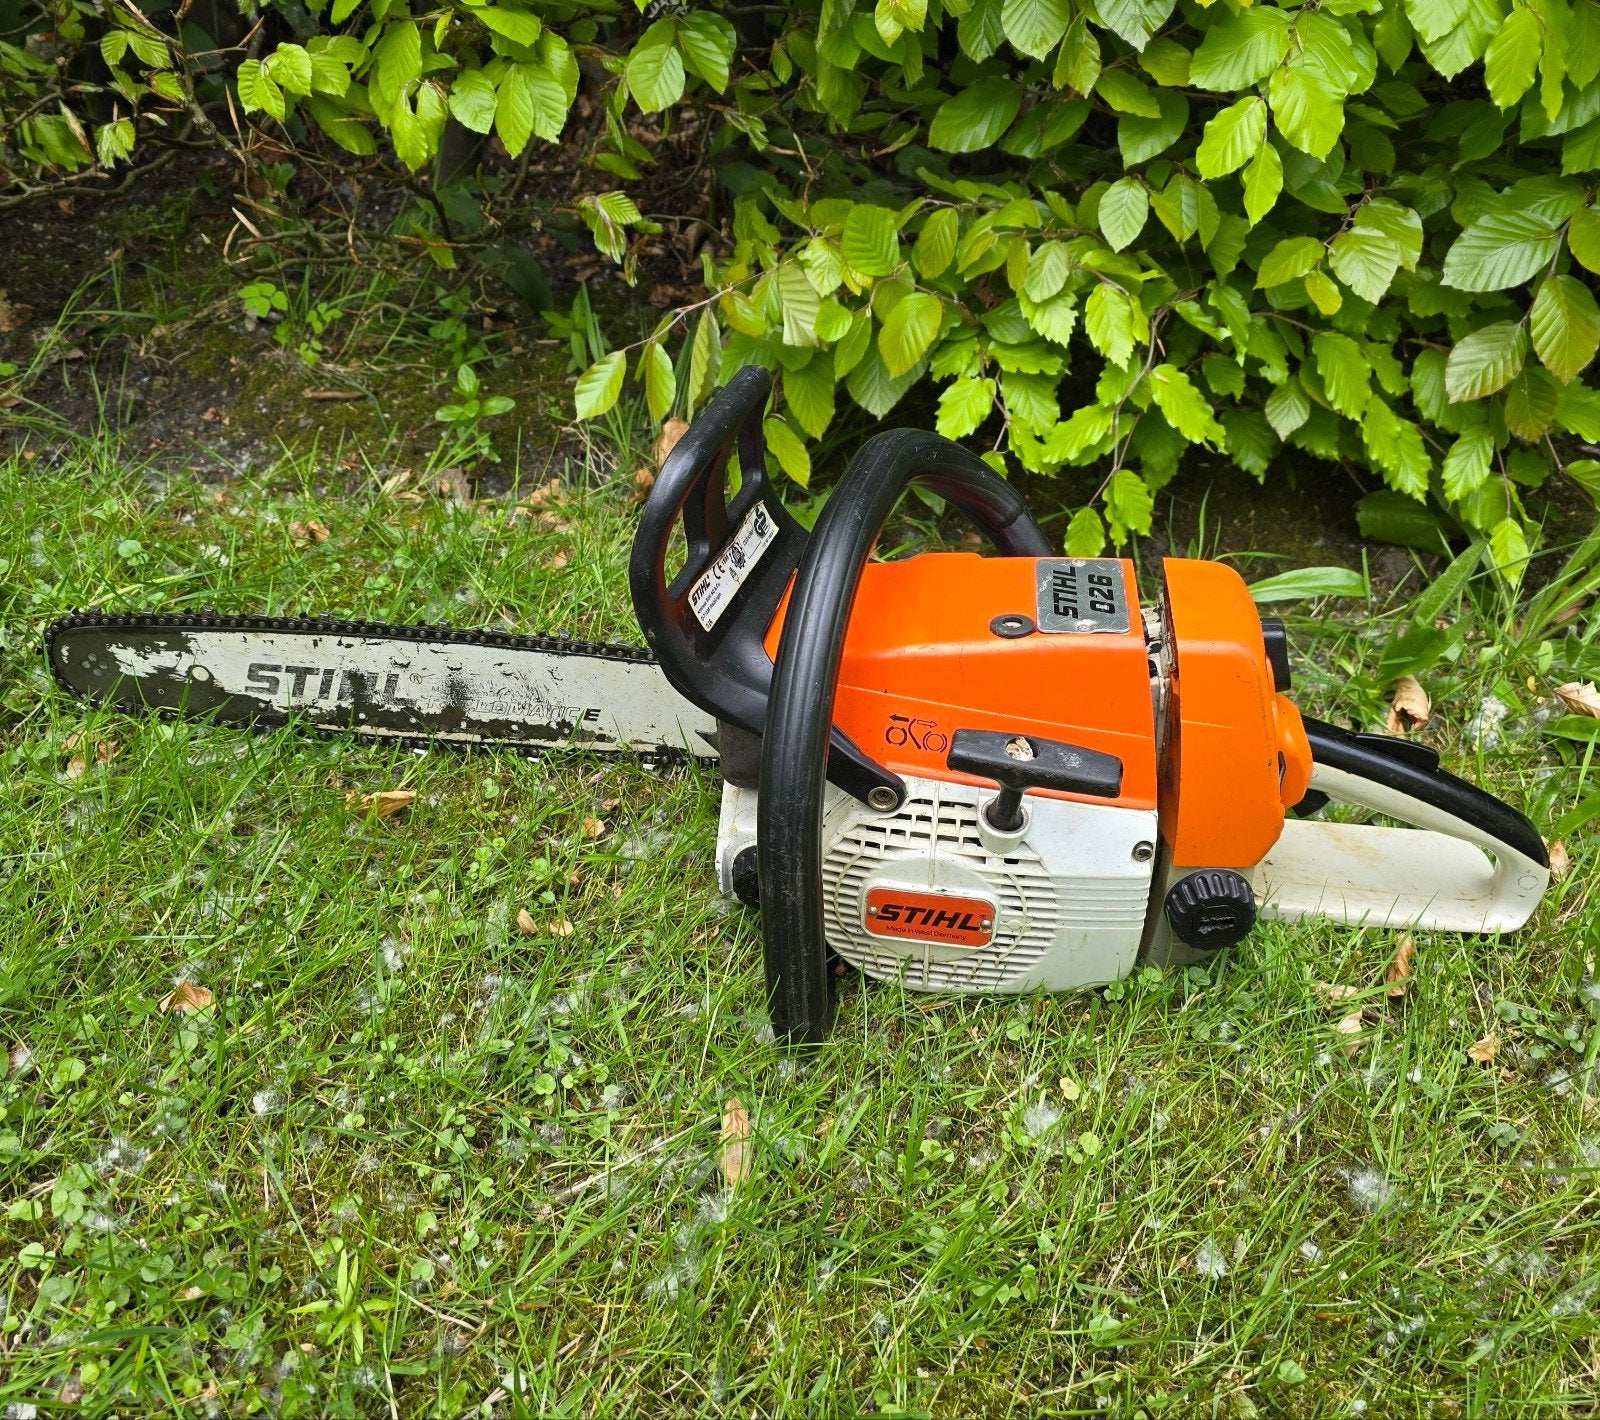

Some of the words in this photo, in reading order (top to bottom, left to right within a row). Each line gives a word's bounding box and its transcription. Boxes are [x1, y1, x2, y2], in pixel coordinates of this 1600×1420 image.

[691, 577, 711, 607] STIHL
[1053, 566, 1078, 619] STIHL
[1088, 574, 1116, 614] 026
[875, 903, 981, 931] STIHL
[914, 928, 933, 937] West
[933, 930, 967, 941] Germany
